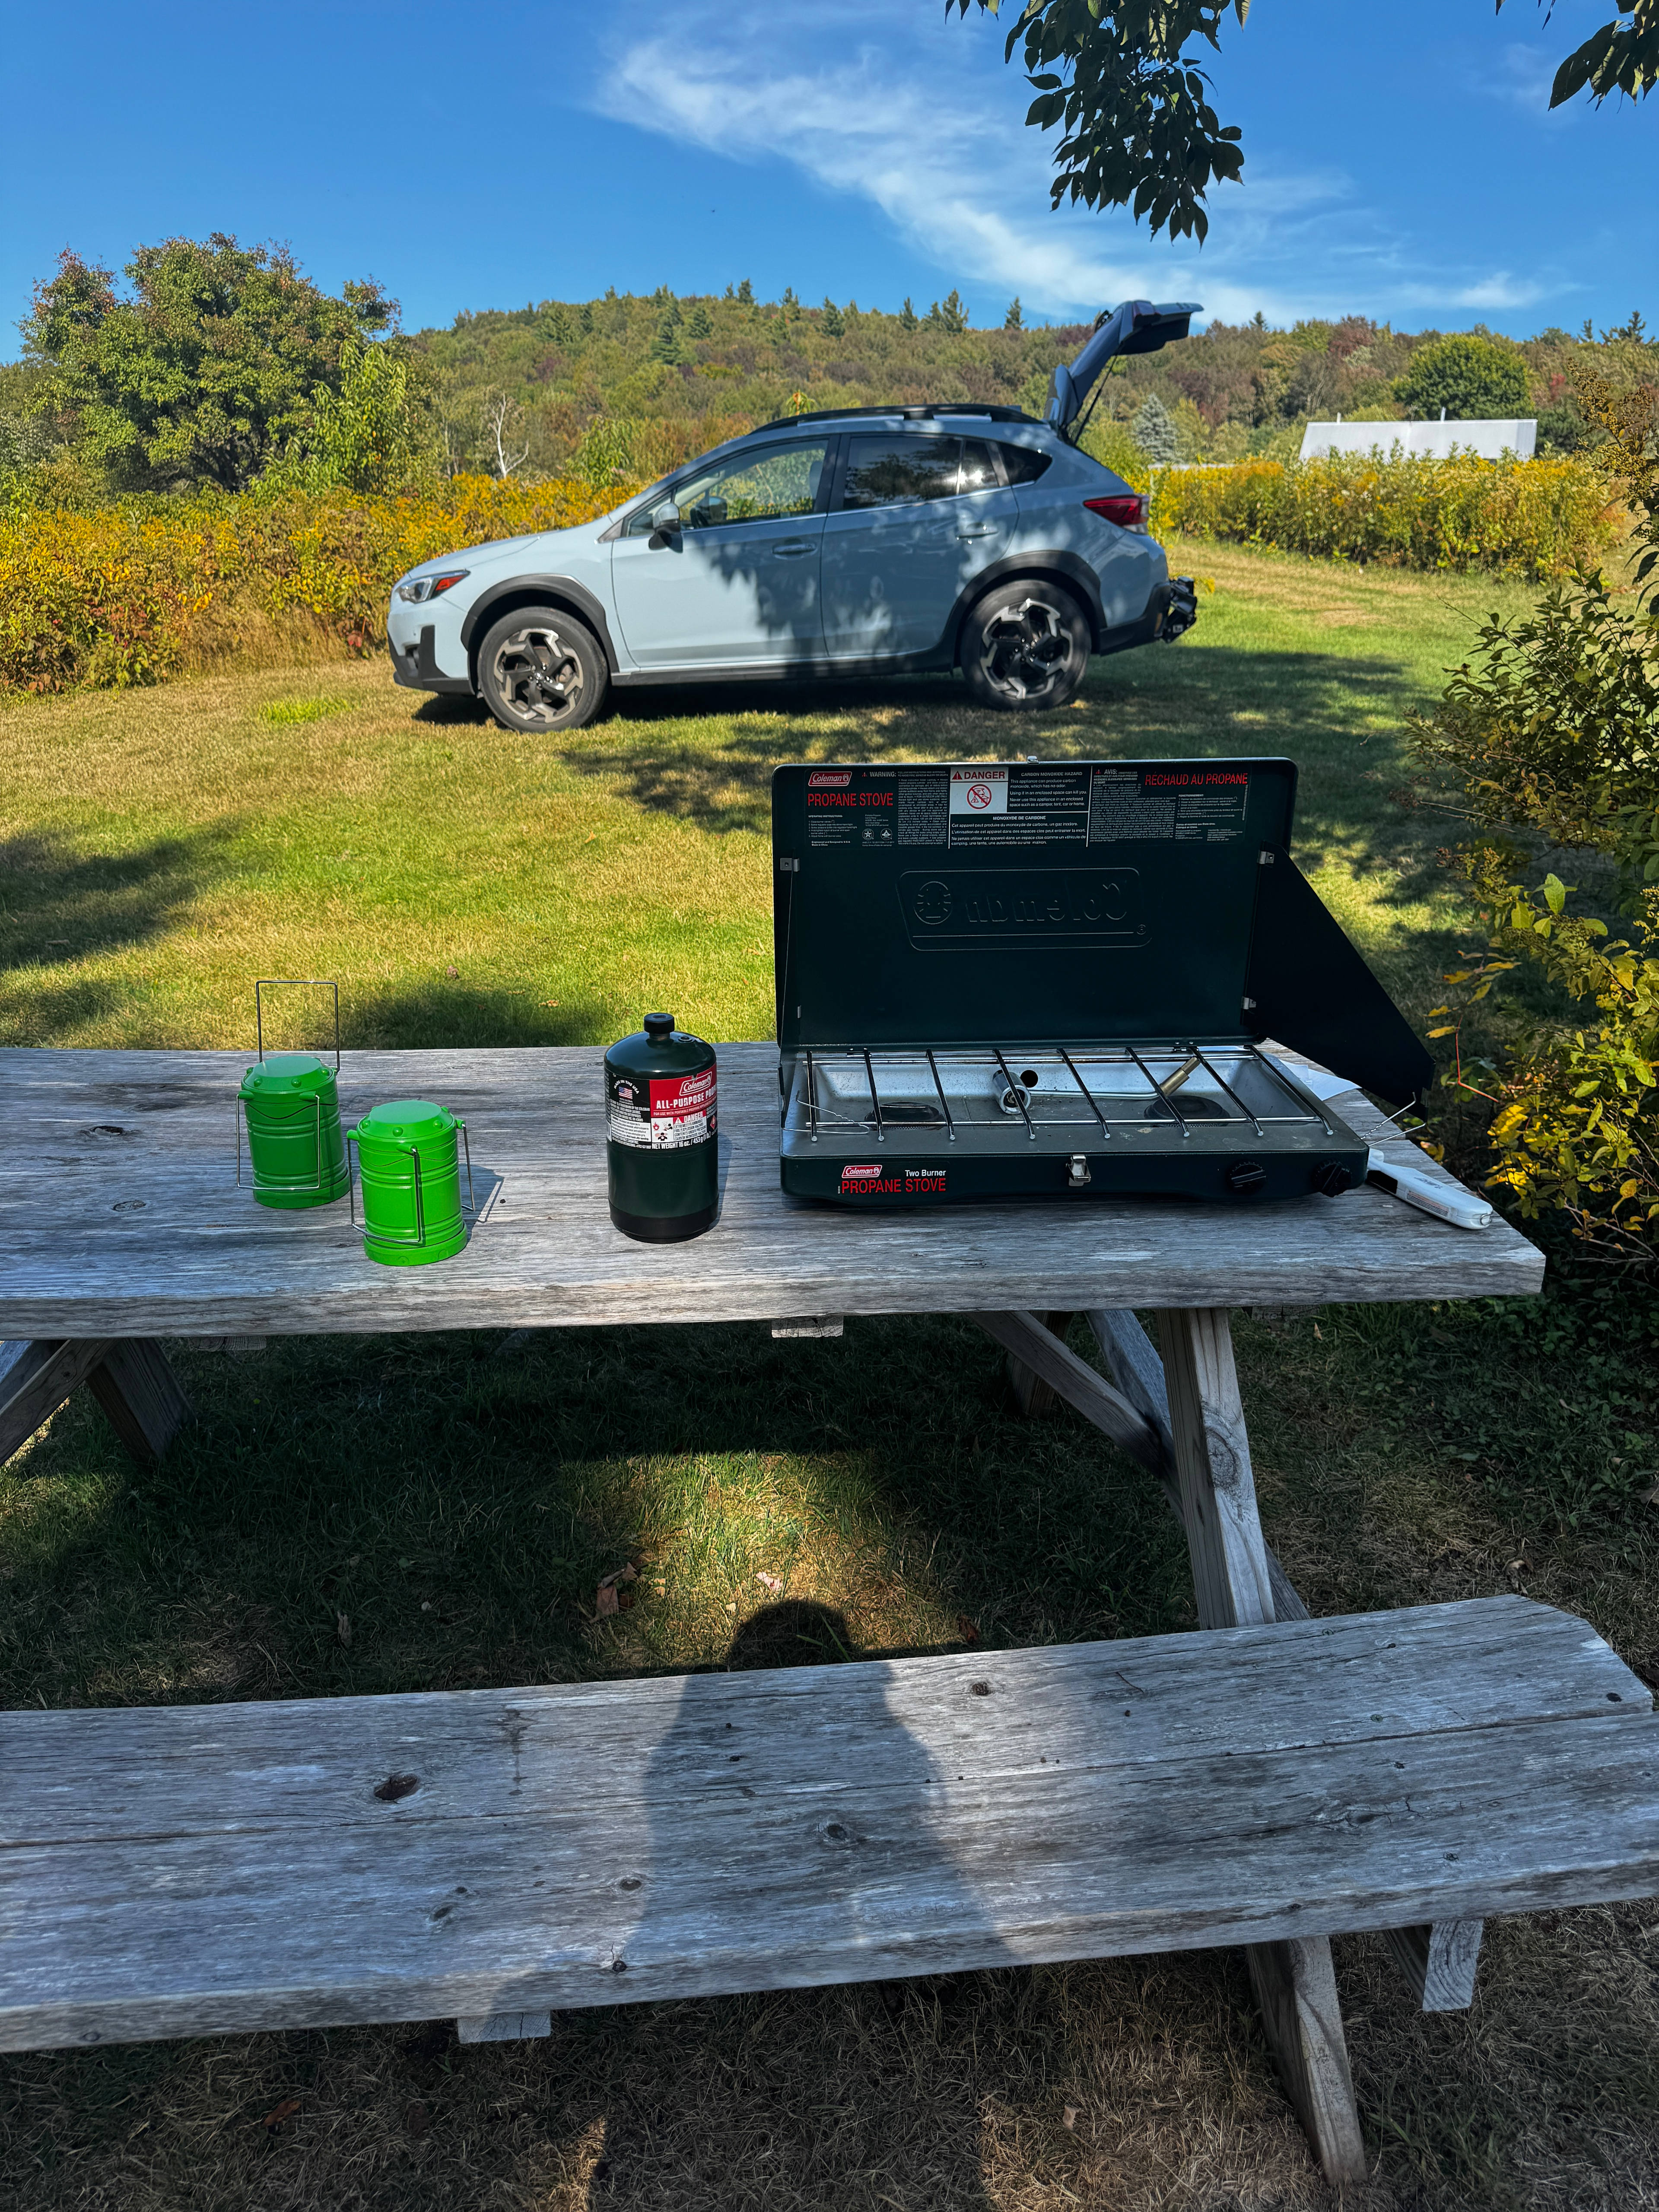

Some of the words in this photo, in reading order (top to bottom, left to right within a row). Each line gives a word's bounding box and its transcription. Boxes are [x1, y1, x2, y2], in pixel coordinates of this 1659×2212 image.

[813, 773, 842, 782] Coleman
[964, 771, 1005, 779] DANGER
[1144, 772, 1188, 786] RÉCHAUD
[1191, 774, 1204, 785] AU
[1206, 773, 1248, 785] PROPANE
[807, 793, 857, 806] PROPANE
[859, 793, 893, 806] STOVE
[683, 1079, 707, 1091] Coleman
[656, 1092, 704, 1109] ALL-PURPOSE
[706, 1084, 716, 1099] PROP
[684, 1111, 703, 1122] DANGER
[845, 1167, 873, 1175] Coleman
[842, 1179, 902, 1194] PROPANE
[905, 1178, 946, 1192] STOVE
